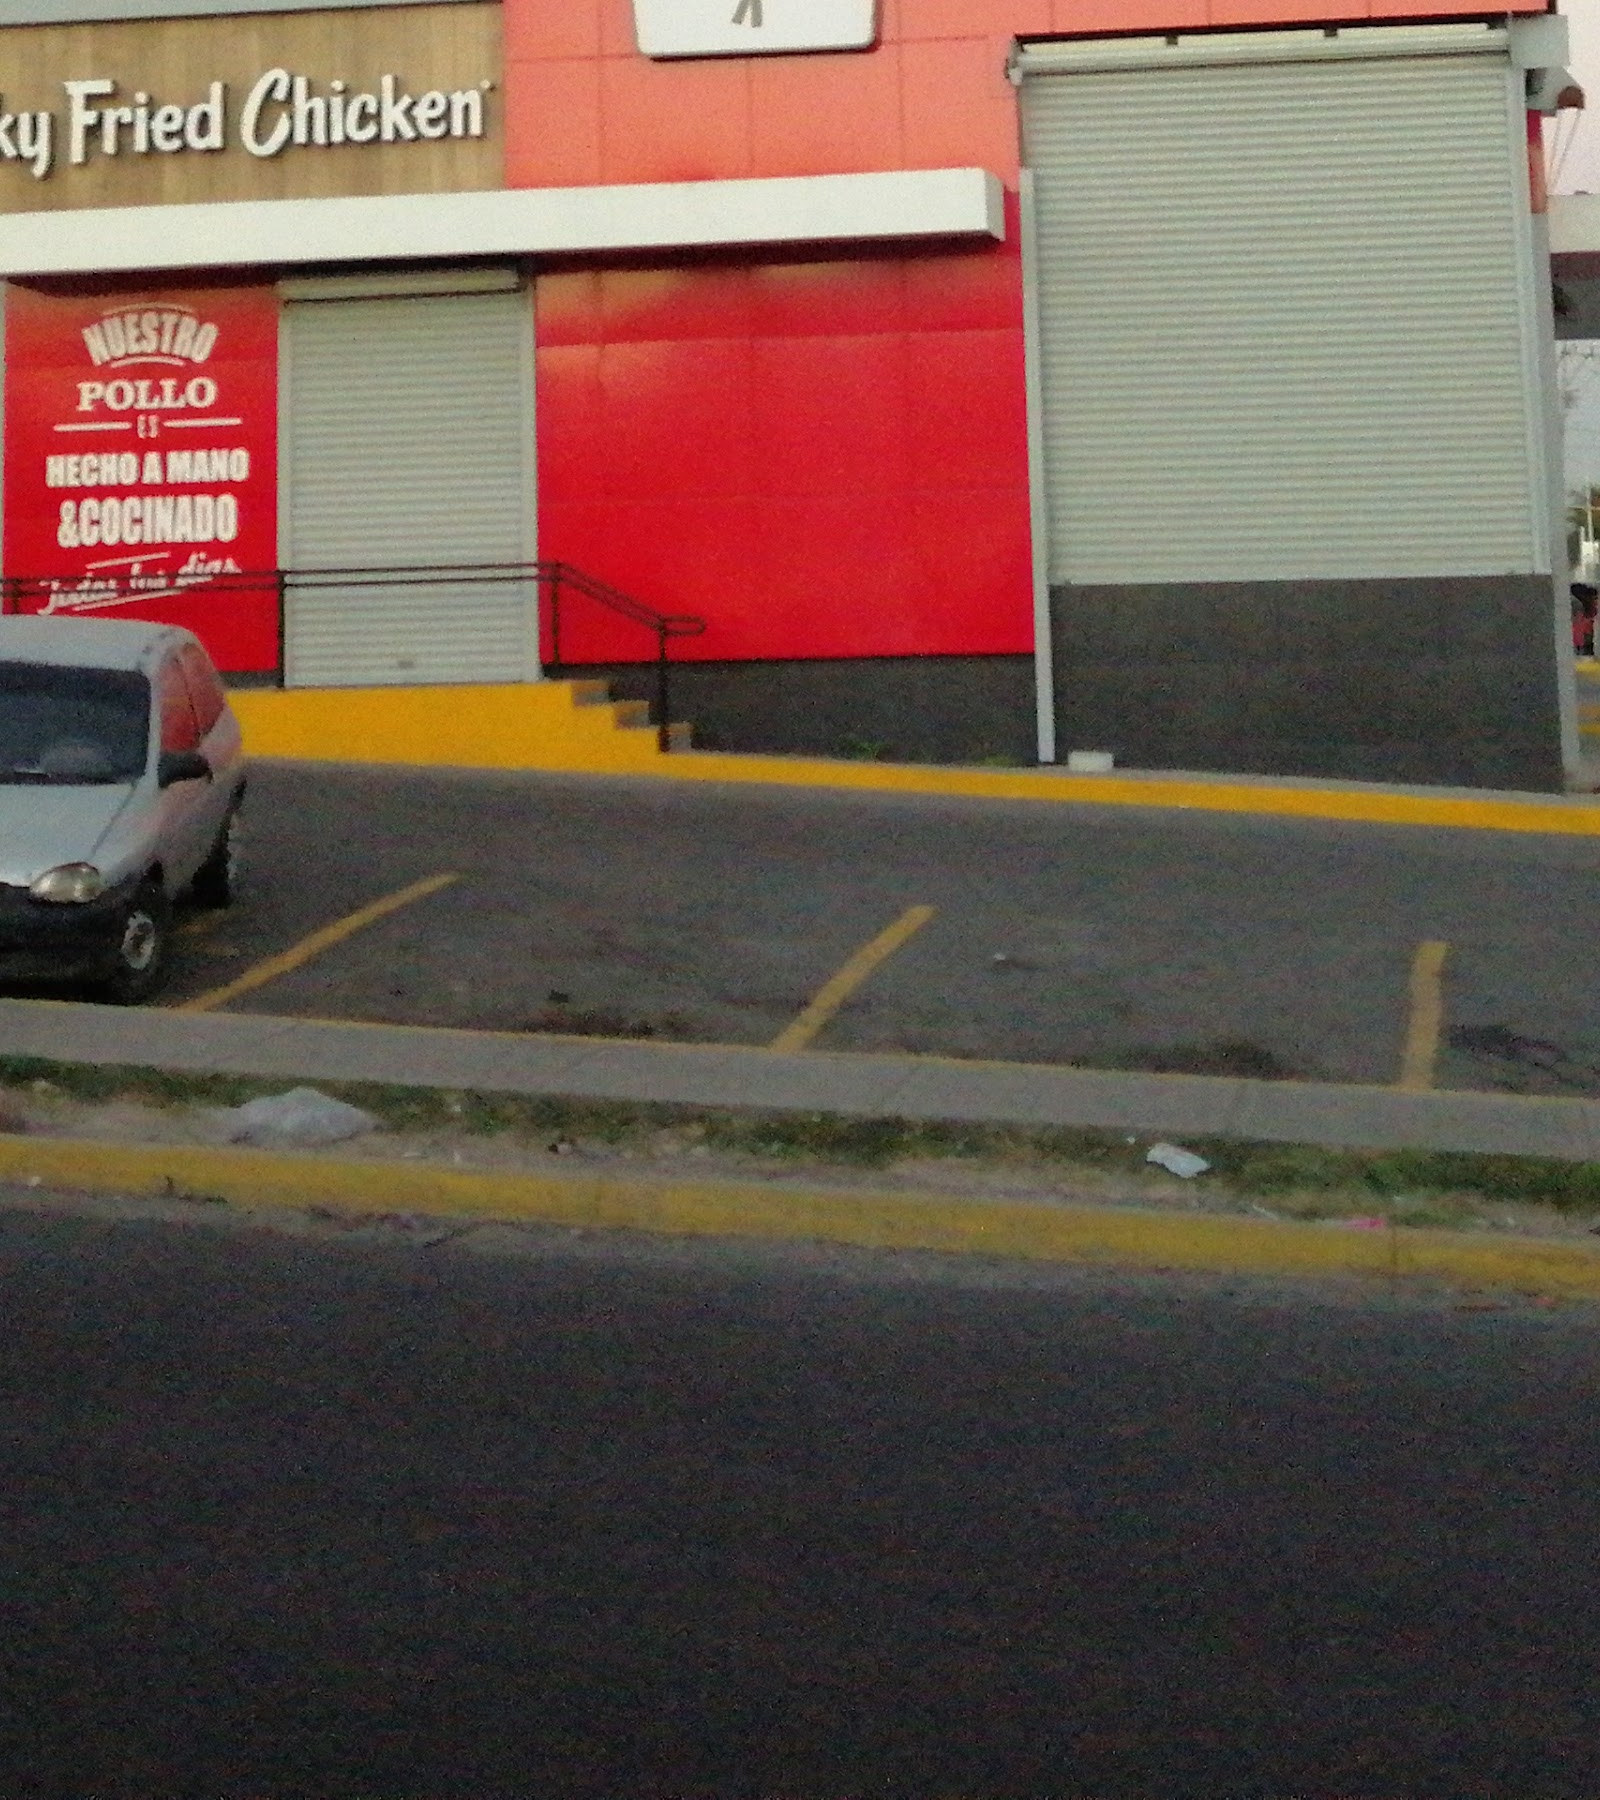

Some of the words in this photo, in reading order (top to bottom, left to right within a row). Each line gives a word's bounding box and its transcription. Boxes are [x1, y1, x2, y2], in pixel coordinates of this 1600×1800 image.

[63, 78, 228, 164] Fried
[240, 67, 484, 157] Chicken
[81, 311, 219, 366] NUESTRO
[76, 376, 218, 411] POLLO
[45, 451, 138, 488] HECHO
[141, 450, 164, 485] A
[166, 446, 250, 483] MANO
